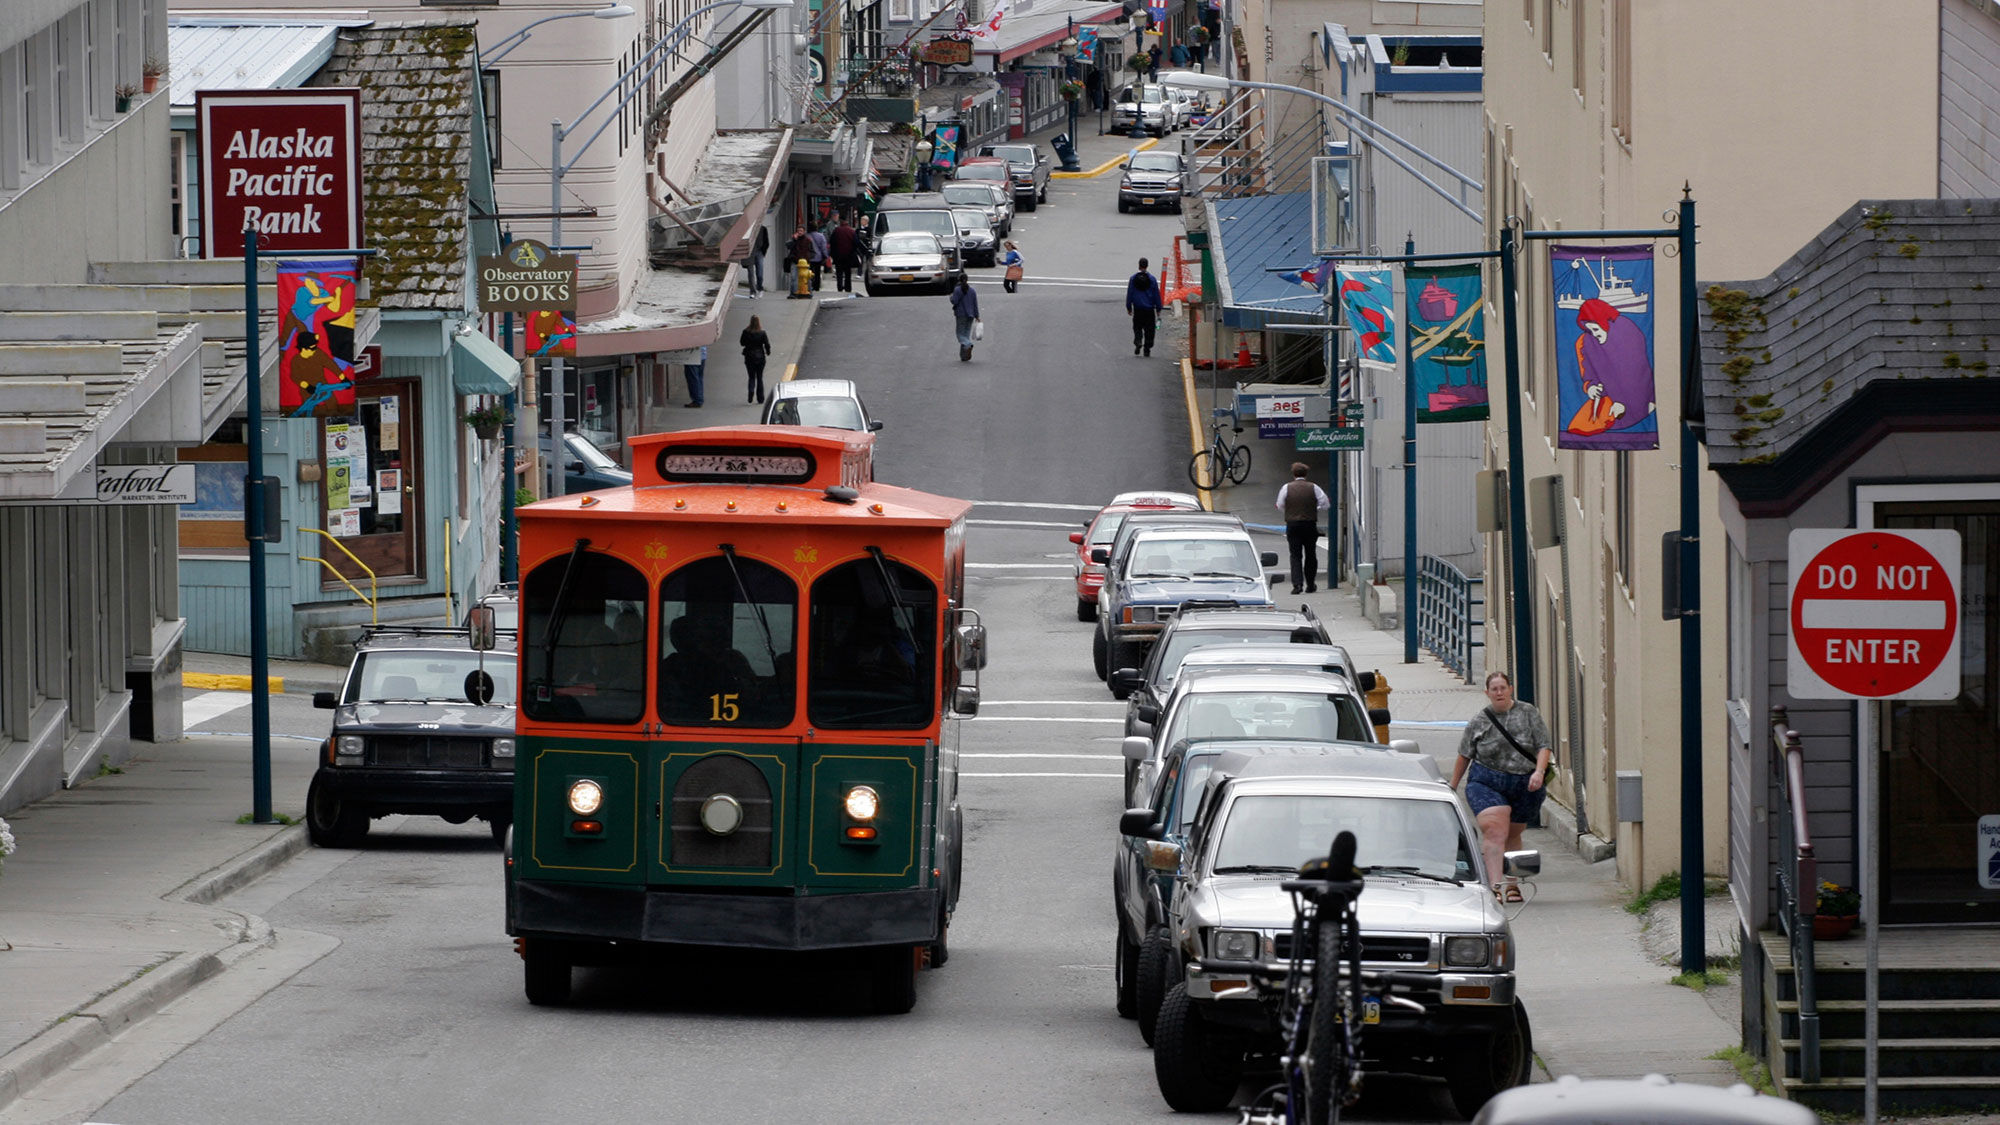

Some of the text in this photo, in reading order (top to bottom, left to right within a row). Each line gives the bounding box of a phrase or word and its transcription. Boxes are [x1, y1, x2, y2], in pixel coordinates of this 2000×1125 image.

[928, 40, 969, 50] LASKAN
[223, 127, 334, 159] Alaska
[226, 165, 334, 197] Pacific
[240, 203, 322, 234] Bank
[483, 267, 573, 283] Observatory
[487, 284, 570, 302] BOOKS
[1272, 401, 1301, 413] aeg
[1302, 430, 1359, 444] Inner Garden
[1159, 497, 1171, 505] CAB
[1818, 565, 1932, 590] DO NOT
[1826, 639, 1921, 664] ENTER
[710, 693, 739, 721] 15
